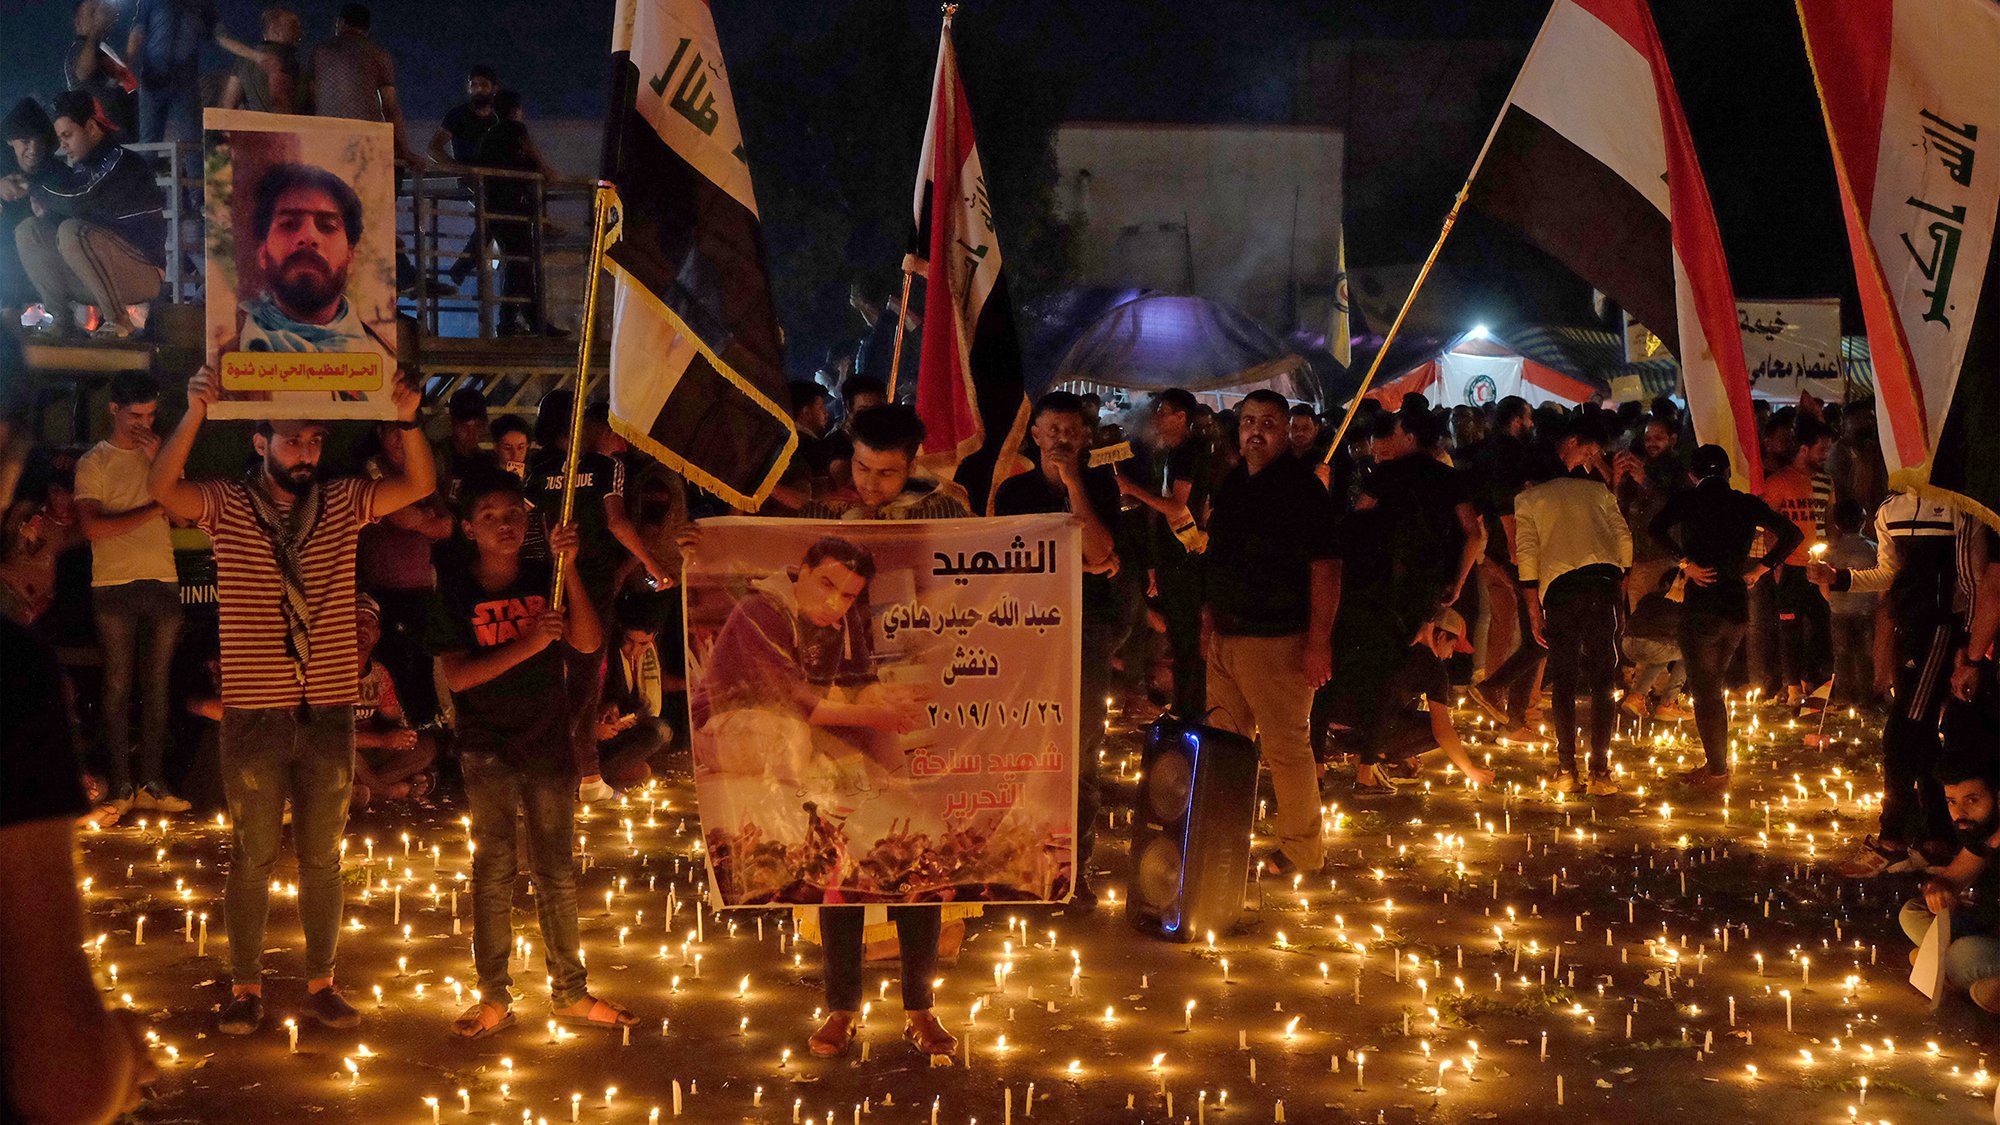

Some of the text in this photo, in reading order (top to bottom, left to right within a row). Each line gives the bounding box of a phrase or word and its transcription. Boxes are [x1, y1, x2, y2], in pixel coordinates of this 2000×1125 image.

[258, 363, 278, 379] ابن
[279, 363, 306, 382] الحي
[544, 475, 566, 490] JUS
[932, 535, 1056, 586] الشهيد
[476, 617, 530, 647] WA
[883, 603, 931, 640] هادي
[933, 604, 983, 636] حيدر
[1024, 603, 1062, 634] عبد
[943, 646, 998, 686] دنفش
[912, 741, 1063, 780] شهيد ساحة
[942, 782, 1025, 819] التحرير
